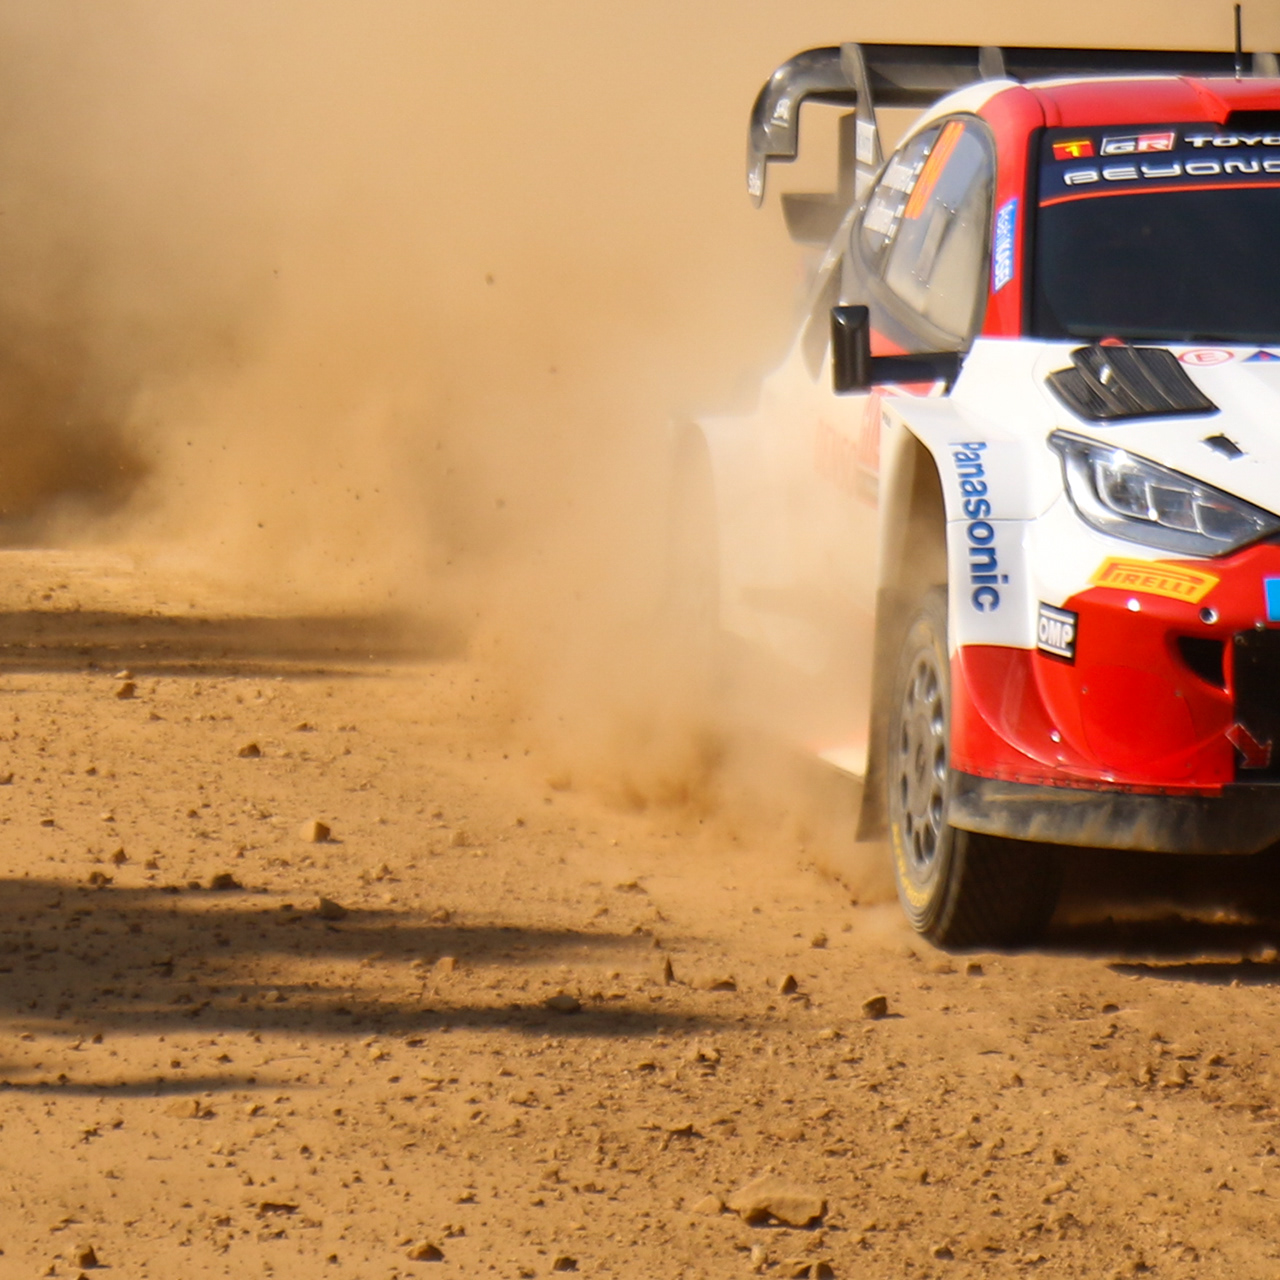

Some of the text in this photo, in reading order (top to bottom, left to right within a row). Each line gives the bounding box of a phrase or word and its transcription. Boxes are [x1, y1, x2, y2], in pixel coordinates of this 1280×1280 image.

[1105, 139, 1170, 153] GR
[949, 441, 1009, 613] Panasonic
[1098, 563, 1206, 597] PIRELLI
[1038, 616, 1075, 650] OMP
